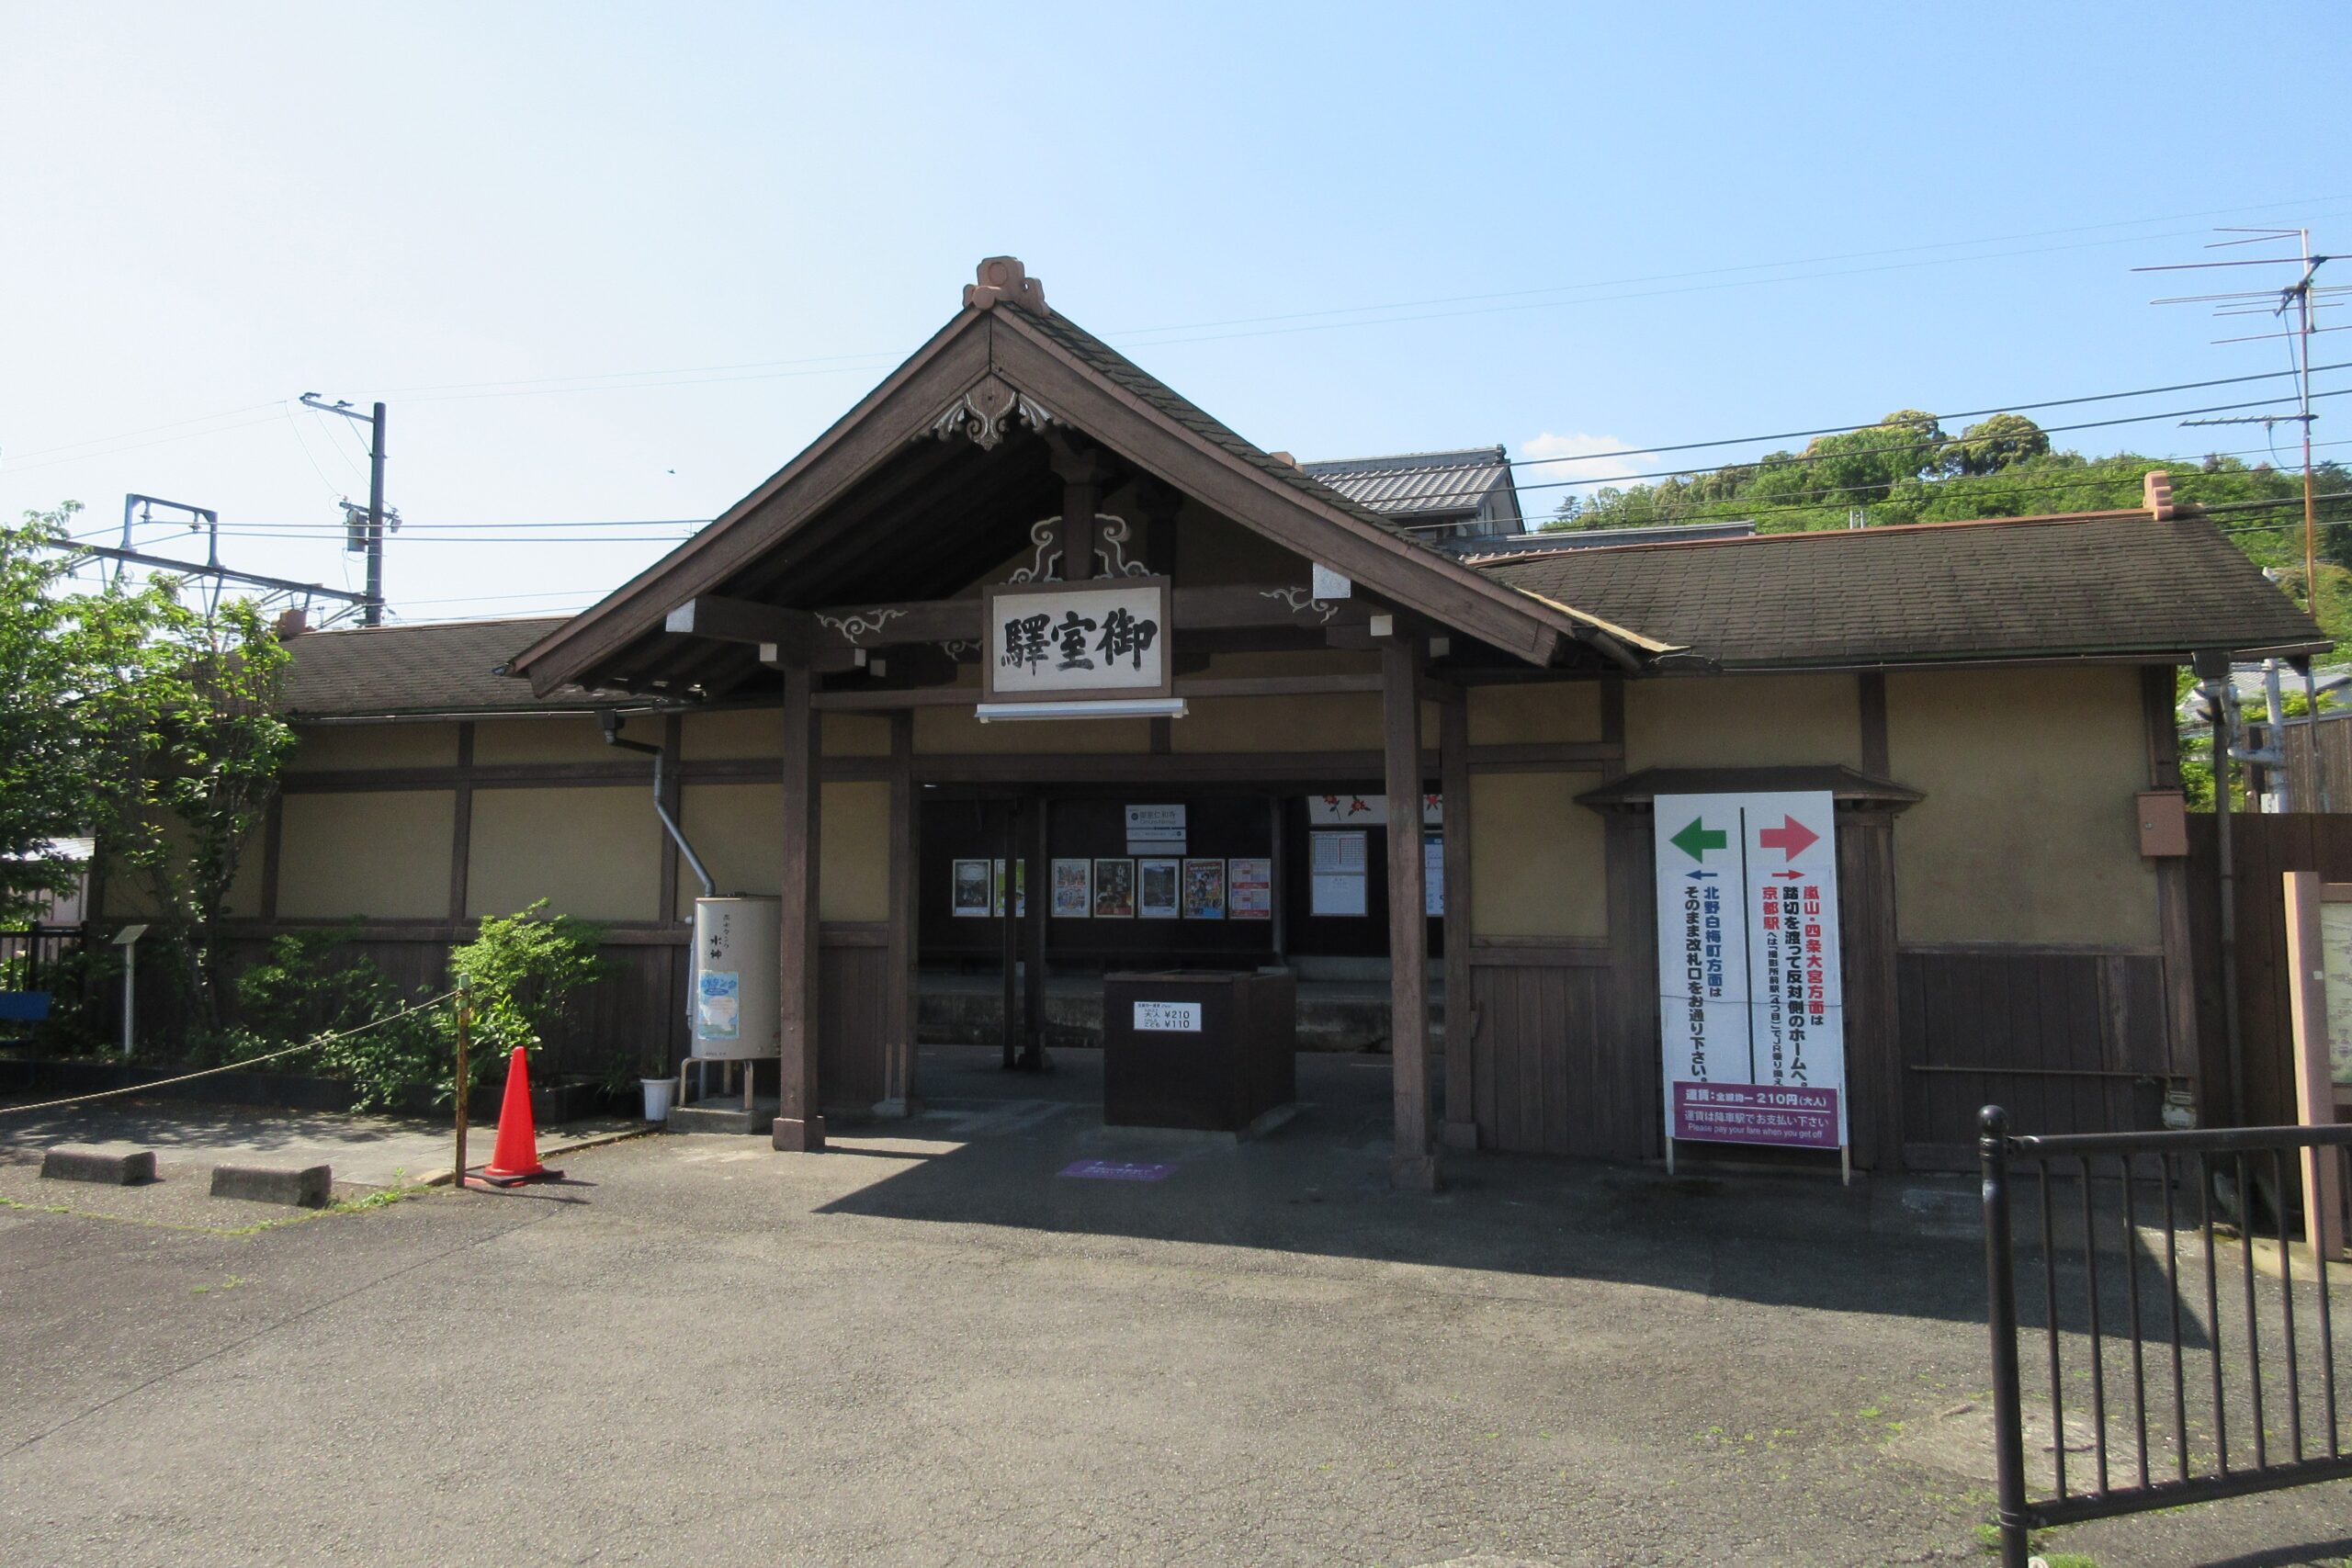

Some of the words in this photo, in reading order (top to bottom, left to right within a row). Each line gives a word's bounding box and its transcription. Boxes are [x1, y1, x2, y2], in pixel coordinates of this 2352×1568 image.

[709, 934, 722, 961] 水神
[1703, 886, 1724, 998] 北野白梅町方面は
[1803, 886, 1824, 1026] 嵐山・四条大宮方面は
[1684, 886, 1707, 1082] そのまま改札口をお通り下さい。
[1164, 1010, 1190, 1019] ¥210
[1164, 1020, 1190, 1029] ¥110
[1688, 1122, 1712, 1133] Please
[1713, 1125, 1727, 1134] pay
[1728, 1126, 1745, 1134] your
[1746, 1125, 1760, 1134] fare
[1762, 1128, 1781, 1136] when
[1783, 1130, 1797, 1138] you
[1799, 1130, 1812, 1139] get
[1812, 1130, 1823, 1138] off
